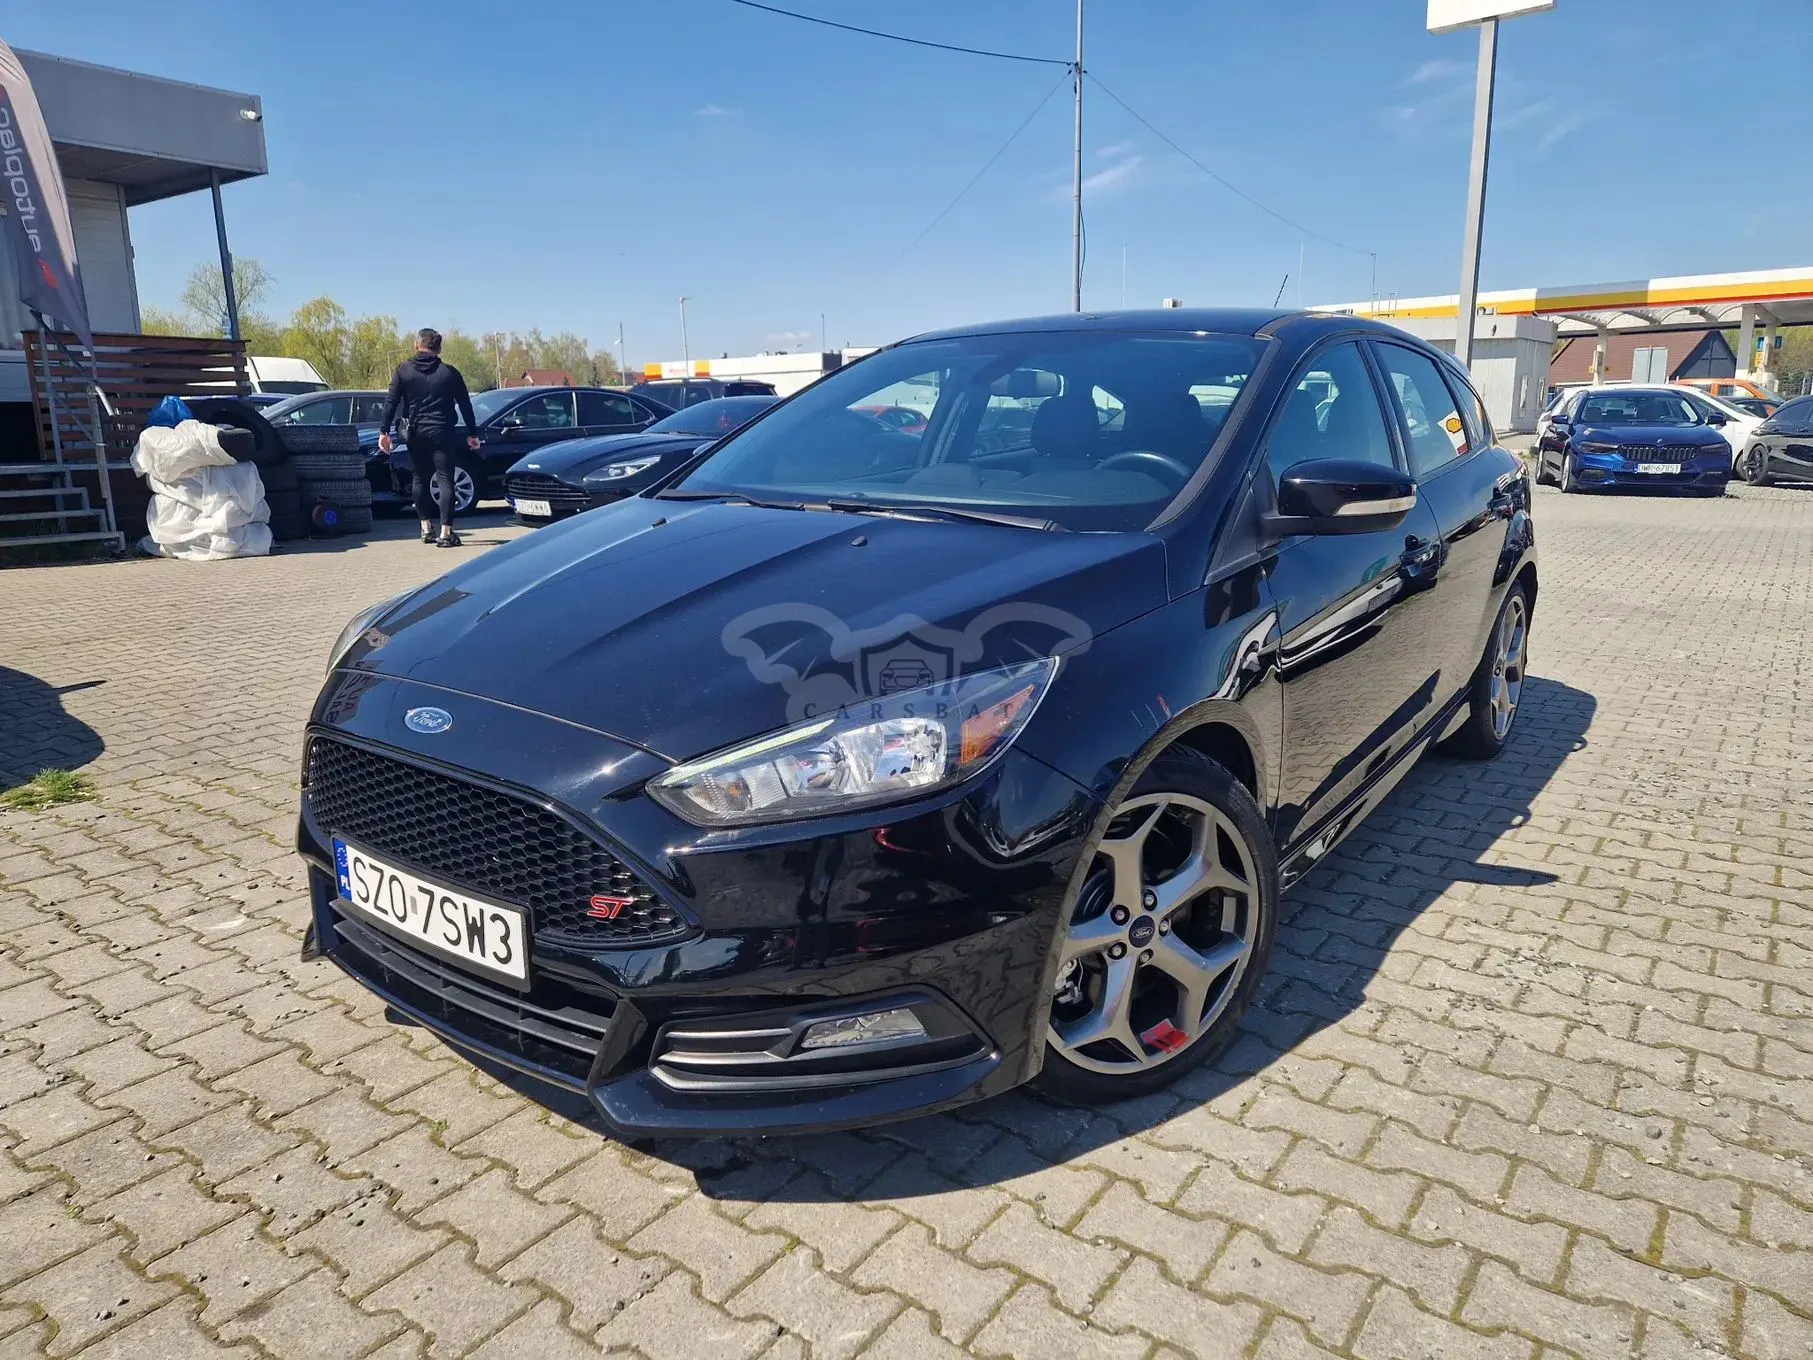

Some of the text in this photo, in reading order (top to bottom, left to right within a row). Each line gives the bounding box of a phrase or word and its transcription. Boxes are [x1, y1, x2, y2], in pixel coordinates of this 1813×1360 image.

[353, 856, 512, 965] SZO 7SW3
[586, 895, 634, 919] ST
